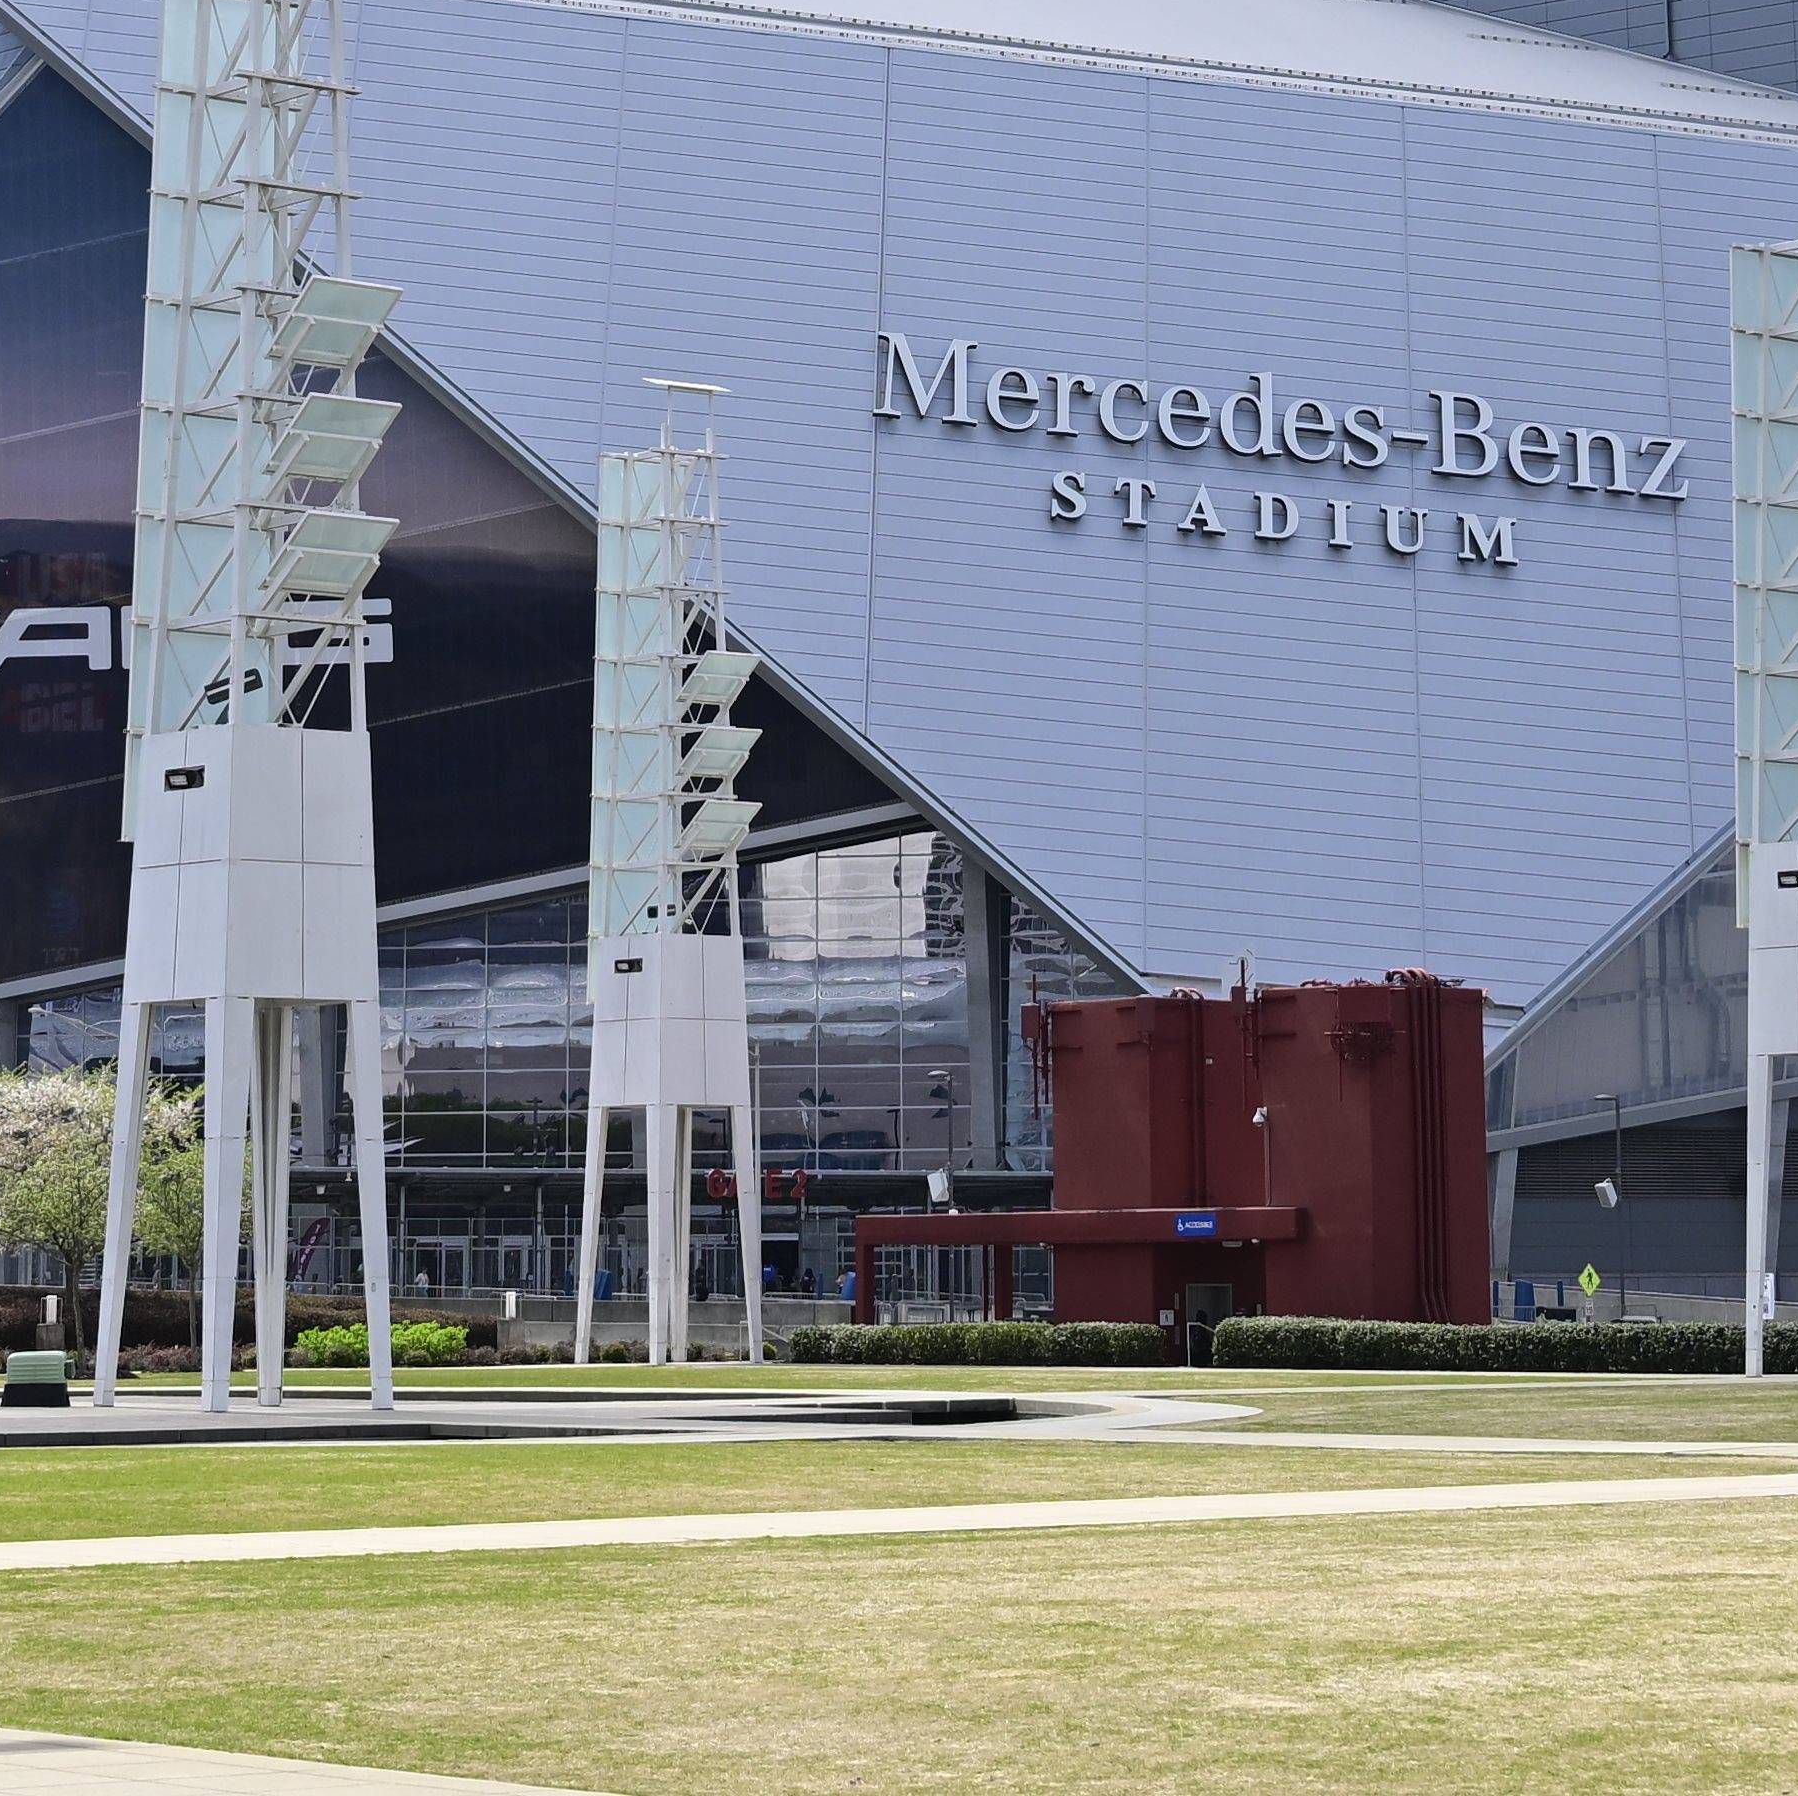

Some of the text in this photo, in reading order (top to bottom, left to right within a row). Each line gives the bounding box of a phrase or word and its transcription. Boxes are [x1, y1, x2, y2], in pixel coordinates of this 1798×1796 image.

[873, 331, 1689, 502] Mercedes-Benz
[1051, 470, 1520, 566] STADIUM
[706, 1168, 808, 1199] GAE 2
